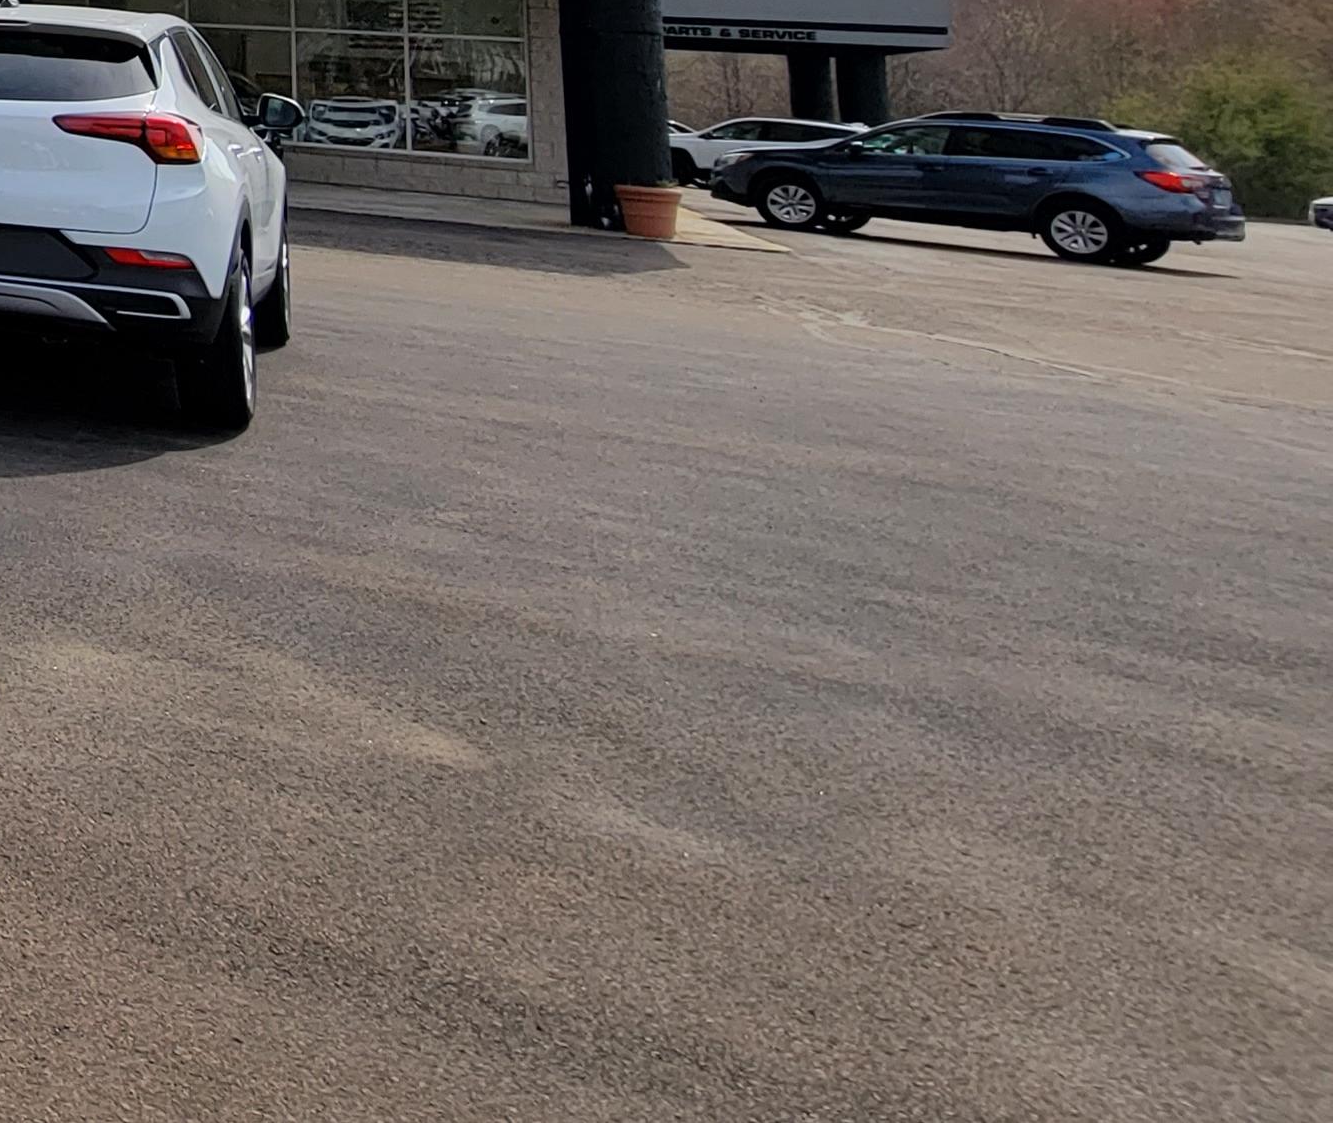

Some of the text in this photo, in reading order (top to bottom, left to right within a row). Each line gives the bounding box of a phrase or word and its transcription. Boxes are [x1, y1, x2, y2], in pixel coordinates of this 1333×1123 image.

[662, 26, 817, 41] ARTS & SERVICE
